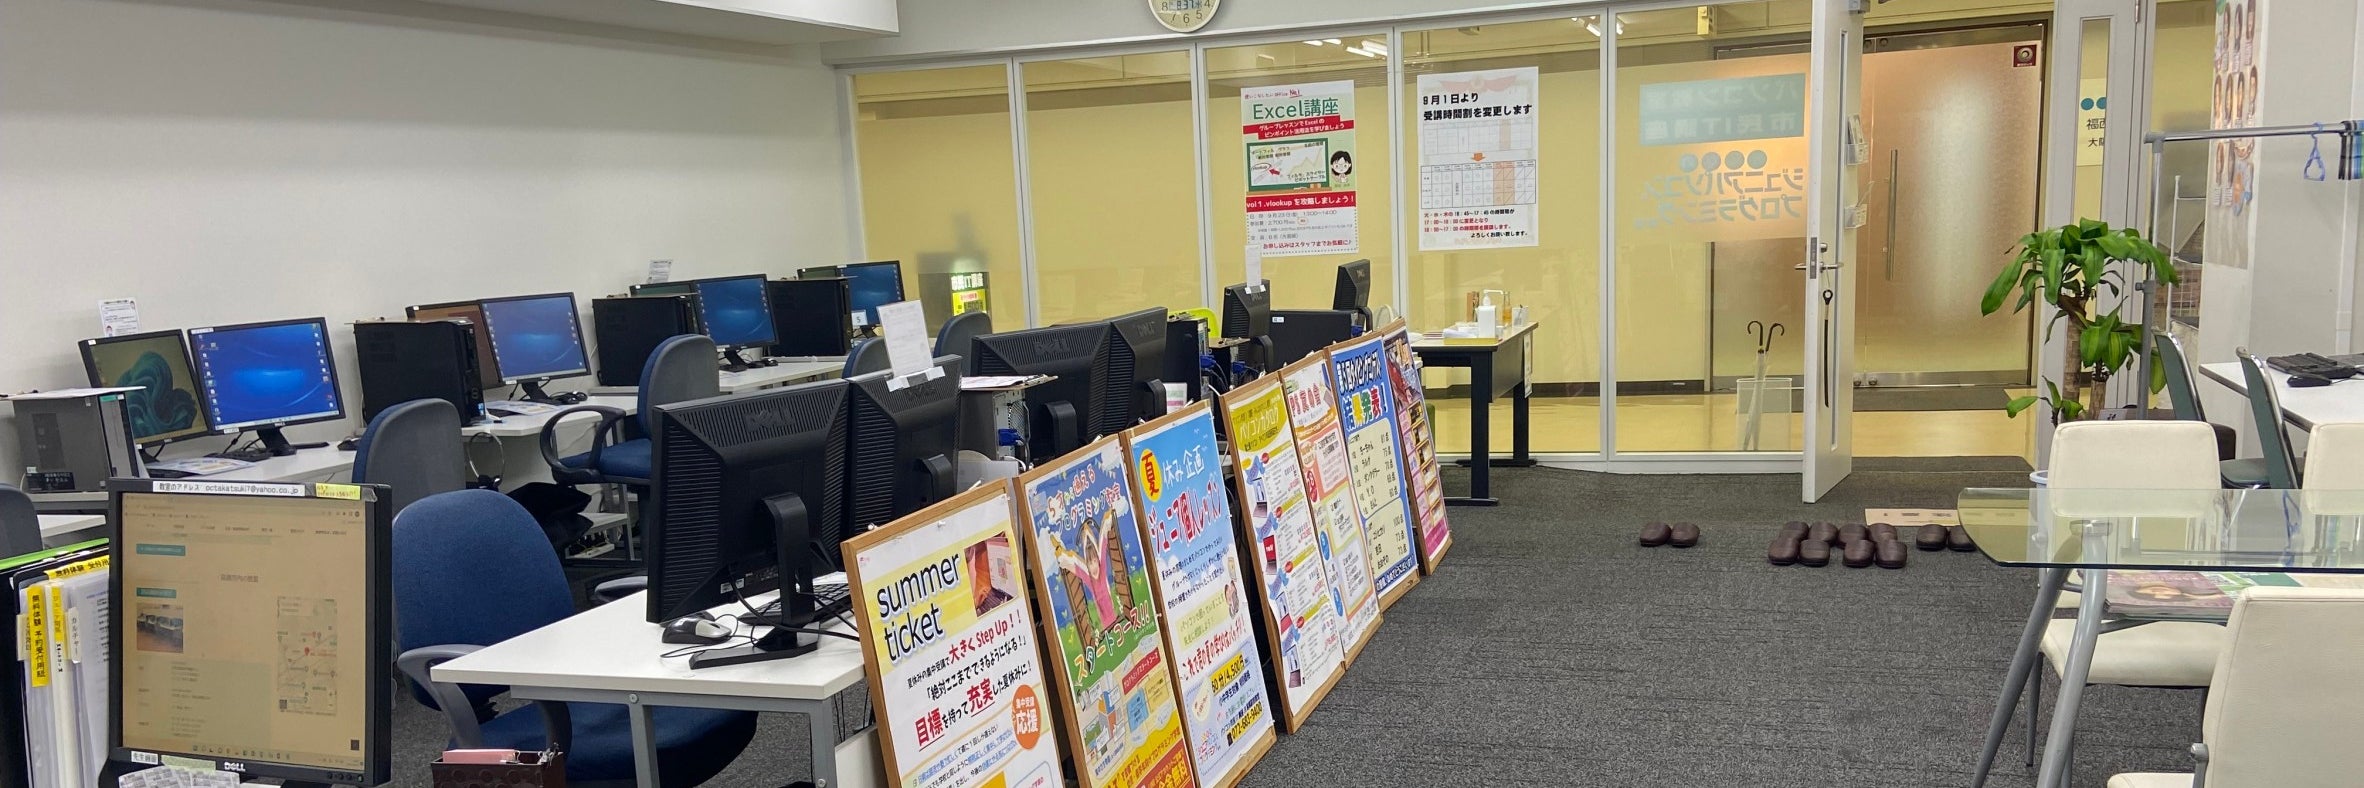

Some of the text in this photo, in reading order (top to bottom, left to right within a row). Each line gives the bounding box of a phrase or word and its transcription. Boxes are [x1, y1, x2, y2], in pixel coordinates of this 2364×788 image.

[1253, 97, 1339, 120] Excel講座
[1423, 104, 1532, 120] 受講時間割を変更します
[158, 482, 200, 492] 教室のアドレス
[877, 553, 959, 618] summer
[71, 616, 80, 655] カルチャー
[884, 603, 944, 661] ticket
[1016, 707, 1038, 735] 応援
[223, 761, 246, 772] DELL
